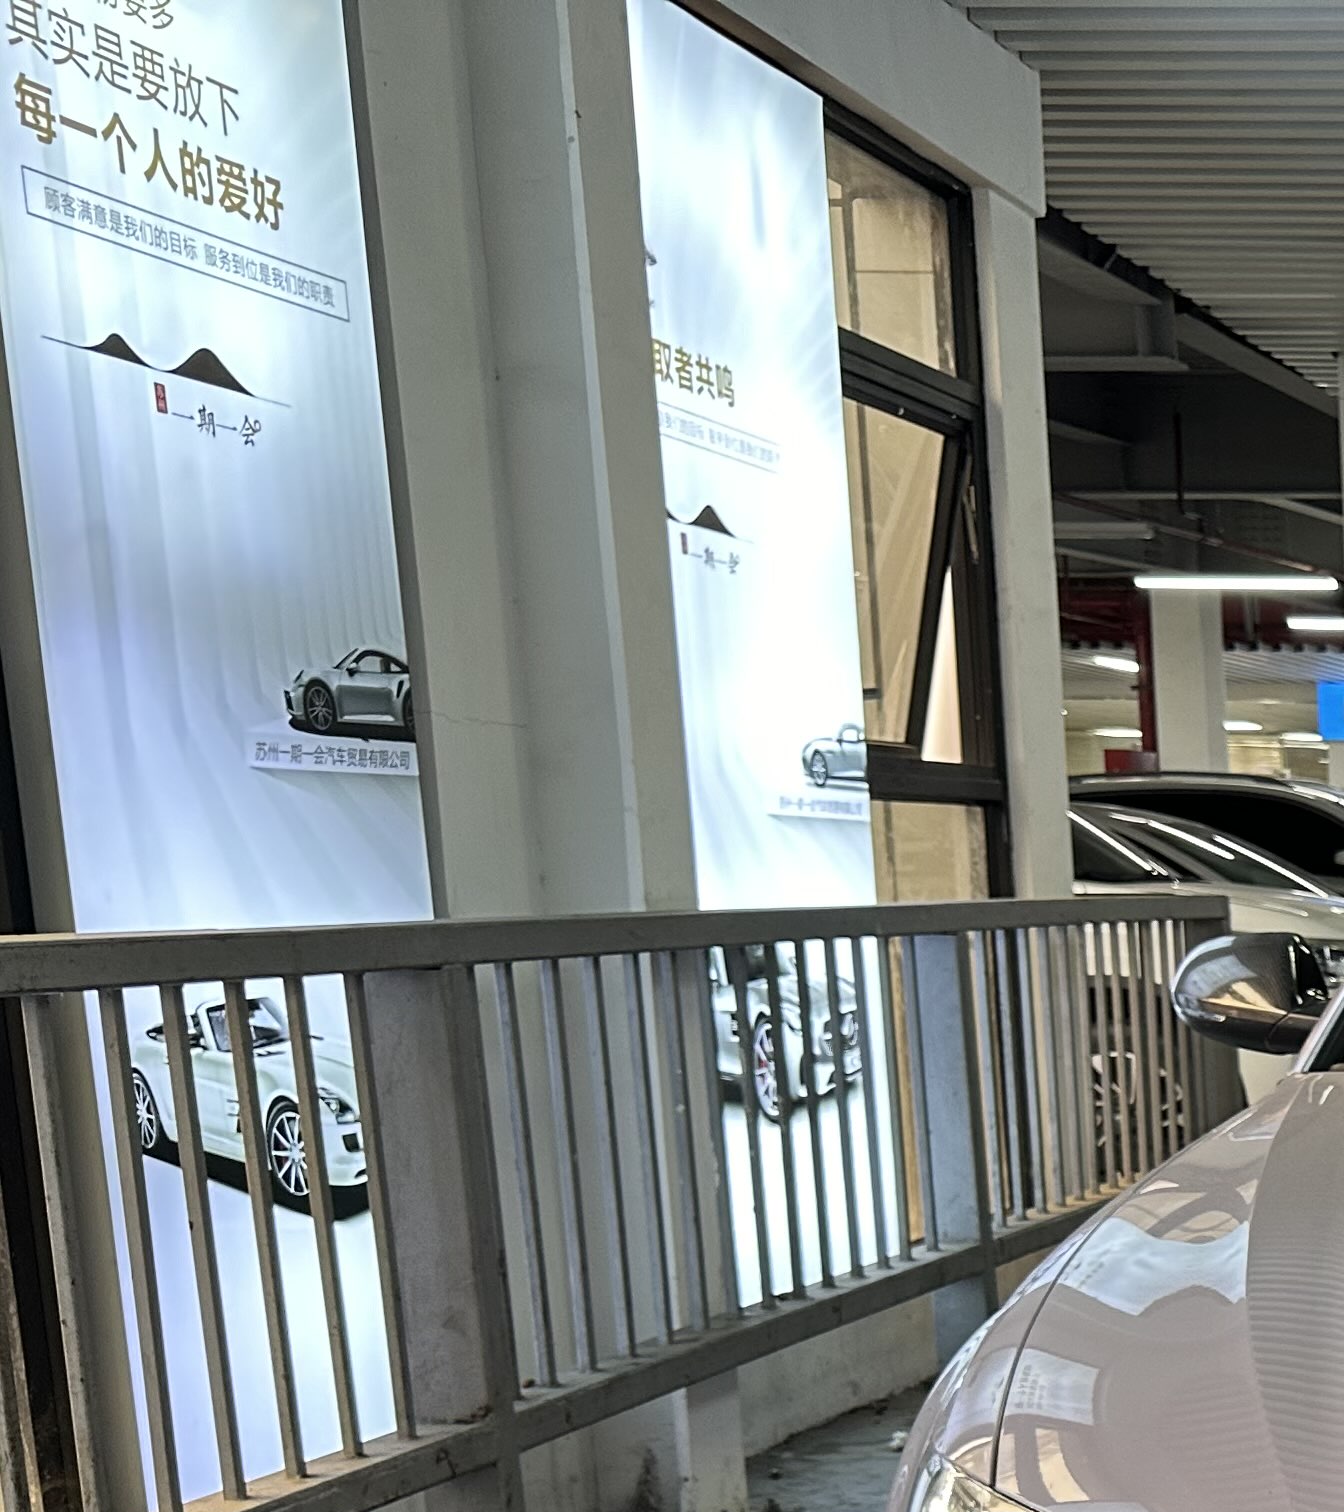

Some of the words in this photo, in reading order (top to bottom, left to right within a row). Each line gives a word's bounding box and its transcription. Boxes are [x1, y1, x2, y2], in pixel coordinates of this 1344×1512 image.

[6, 0, 240, 136] 其实是要放下
[14, 73, 284, 231] 每一个人的爱好
[44, 186, 198, 261] 顾客满意是我们的目标
